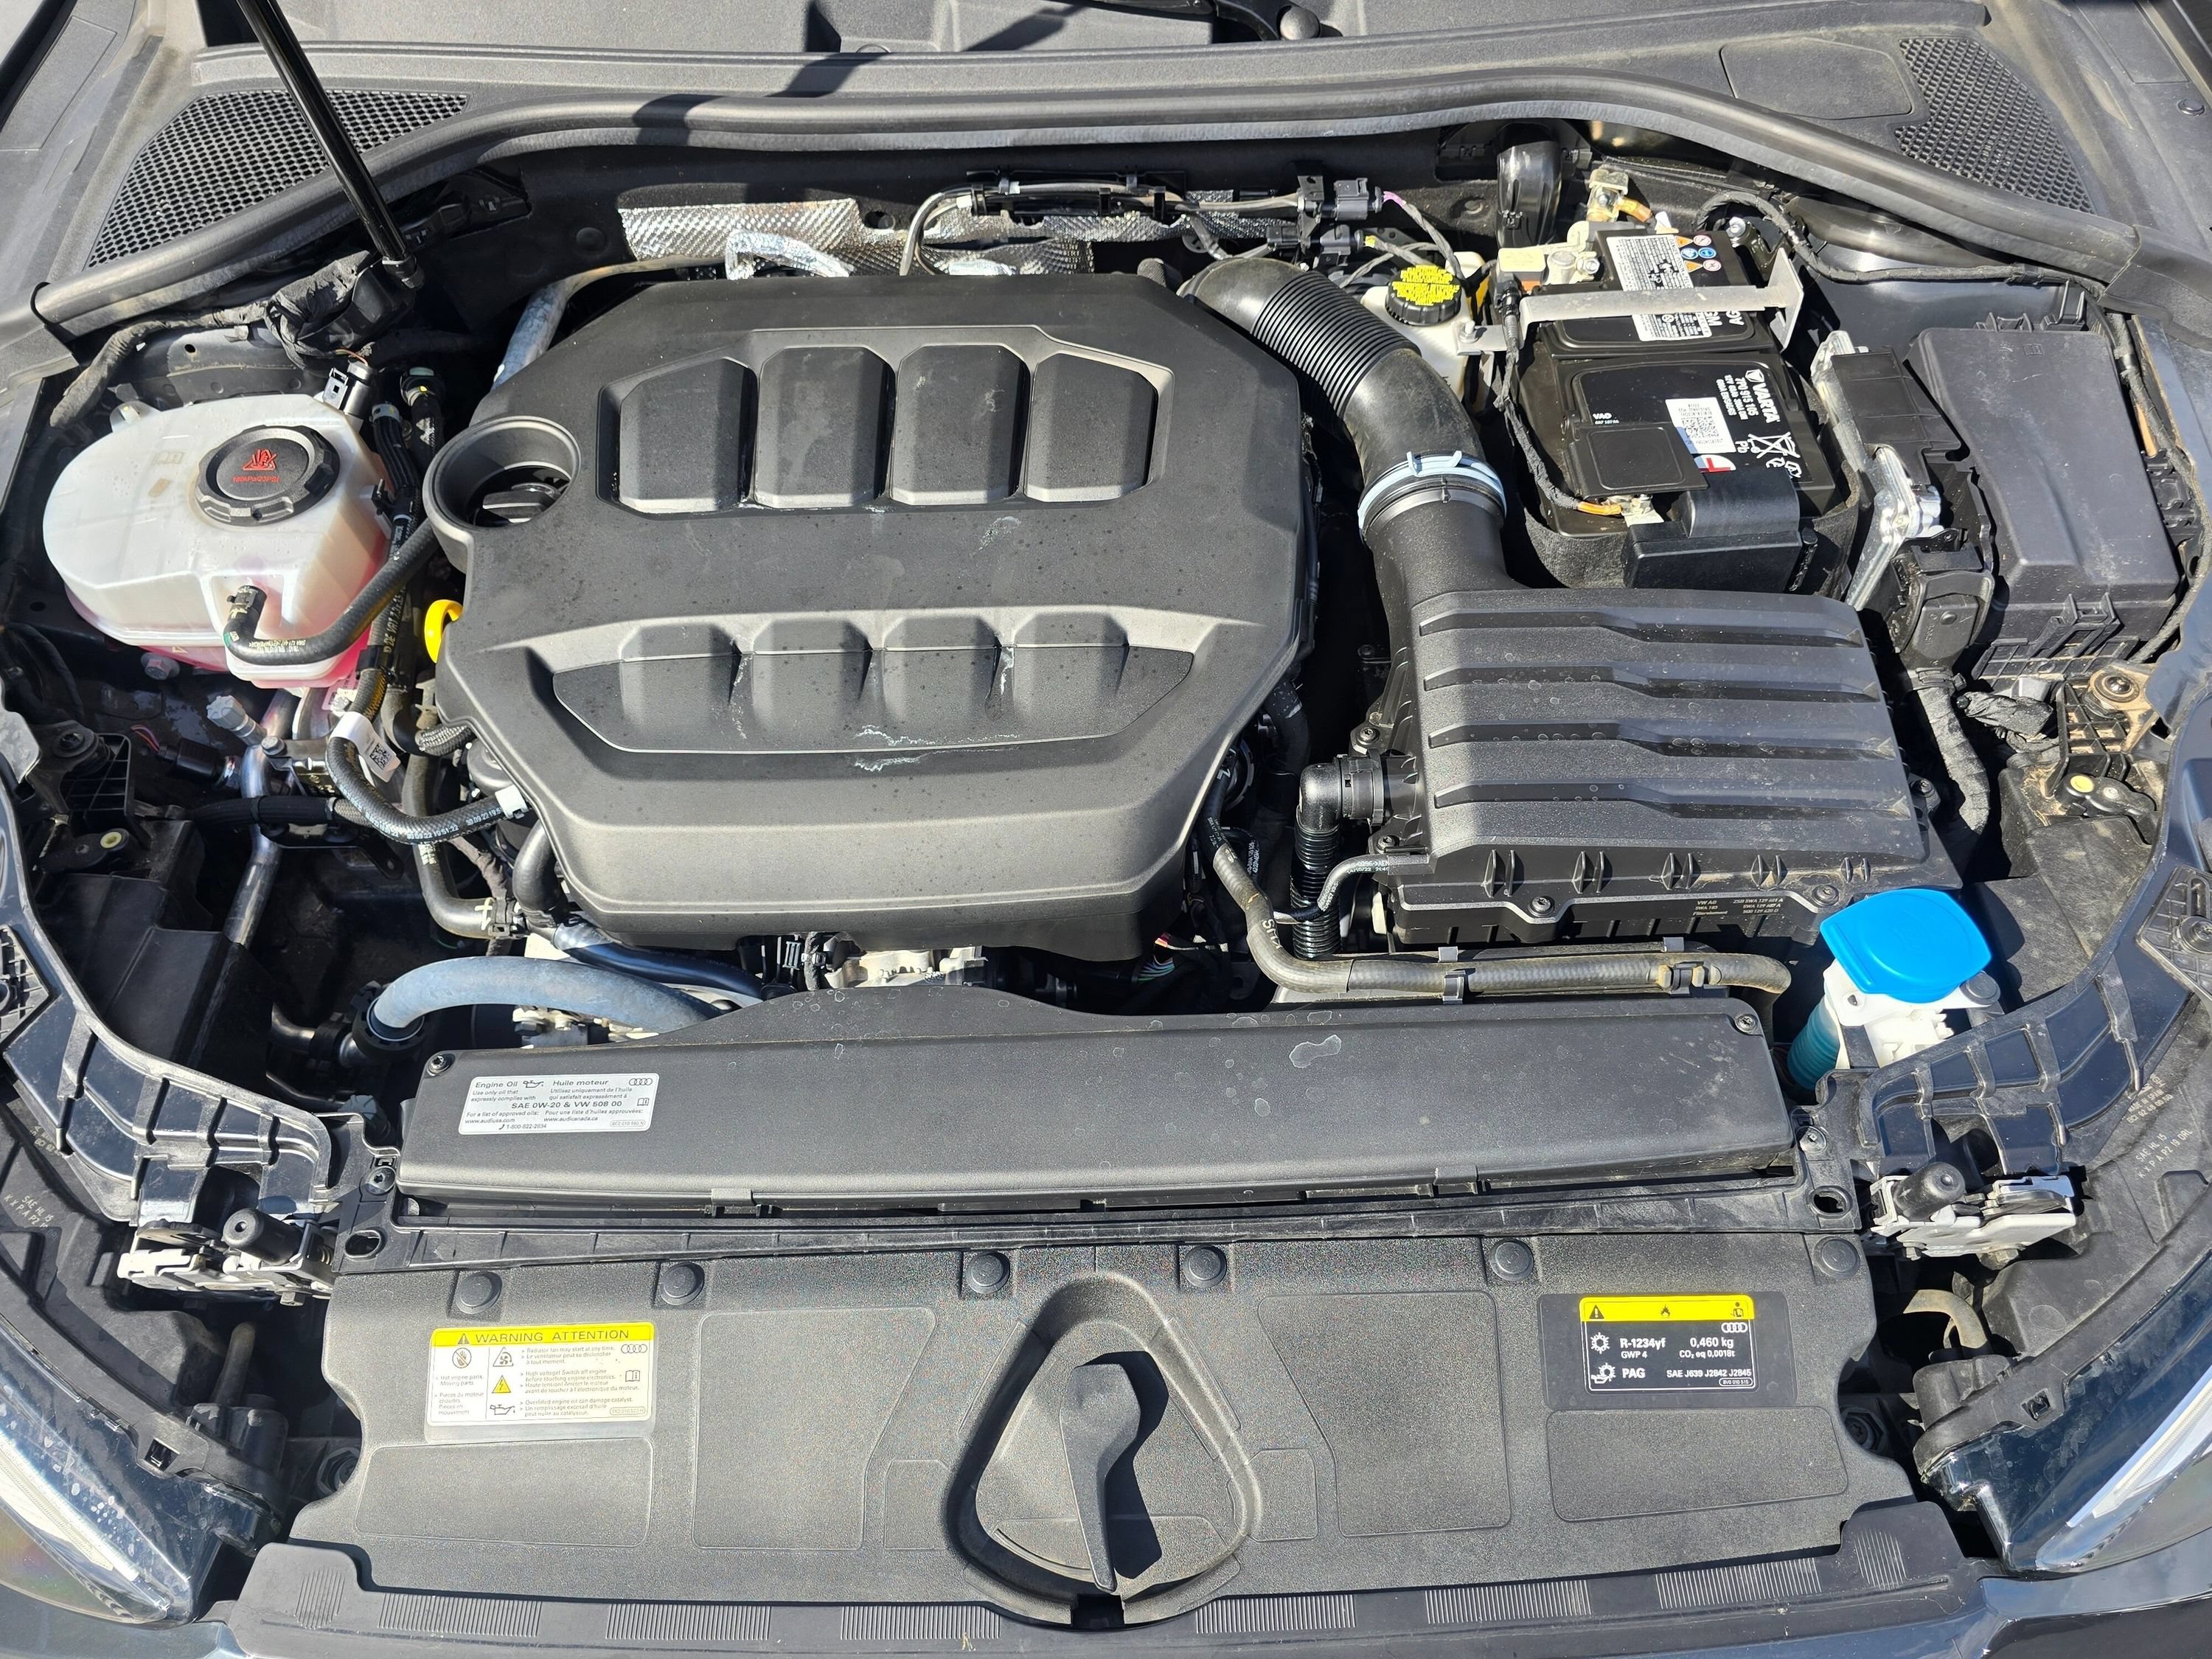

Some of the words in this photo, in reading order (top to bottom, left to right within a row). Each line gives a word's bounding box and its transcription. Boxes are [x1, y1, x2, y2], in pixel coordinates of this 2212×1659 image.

[1739, 388, 1753, 404] 915
[1753, 383, 1779, 423] VARTA
[1734, 439, 1750, 455] Pb
[2127, 1102, 2143, 1113] MADE
[2147, 1088, 2165, 1101] SPAIN
[2135, 1148, 2151, 1163] SAE
[2148, 1141, 2160, 1151] HL
[2156, 1133, 2167, 1143] 15
[2137, 1171, 2146, 1179] K
[2149, 1160, 2157, 1168] P
[2156, 1154, 2164, 1162] A
[2161, 1145, 2174, 1157] P2
[2170, 1138, 2181, 1147] 19
[2177, 1128, 2193, 1141] DRL
[4, 1194, 13, 1203] K
[10, 1199, 18, 1208] X
[15, 1203, 24, 1211] P
[21, 1209, 30, 1217] A
[28, 1214, 40, 1225] P2
[21, 1194, 38, 1209] SAE
[35, 1206, 46, 1216] HL
[44, 1213, 55, 1222] 15
[475, 1332, 544, 1344] WARNING
[552, 1329, 630, 1341] ATTENTION
[1619, 1338, 1666, 1350] R-1234yf
[1689, 1337, 1719, 1349] 0,460
[1721, 1337, 1734, 1349] kg
[1621, 1351, 1641, 1359] GWP
[1695, 1351, 1706, 1360] eq
[1707, 1349, 1736, 1358] 0,0018t
[1621, 1368, 1646, 1379] PAG
[1666, 1369, 1683, 1378] SAE
[1684, 1369, 1703, 1378] J639
[1705, 1369, 1728, 1377] J2842
[1728, 1368, 1752, 1377] J2845
